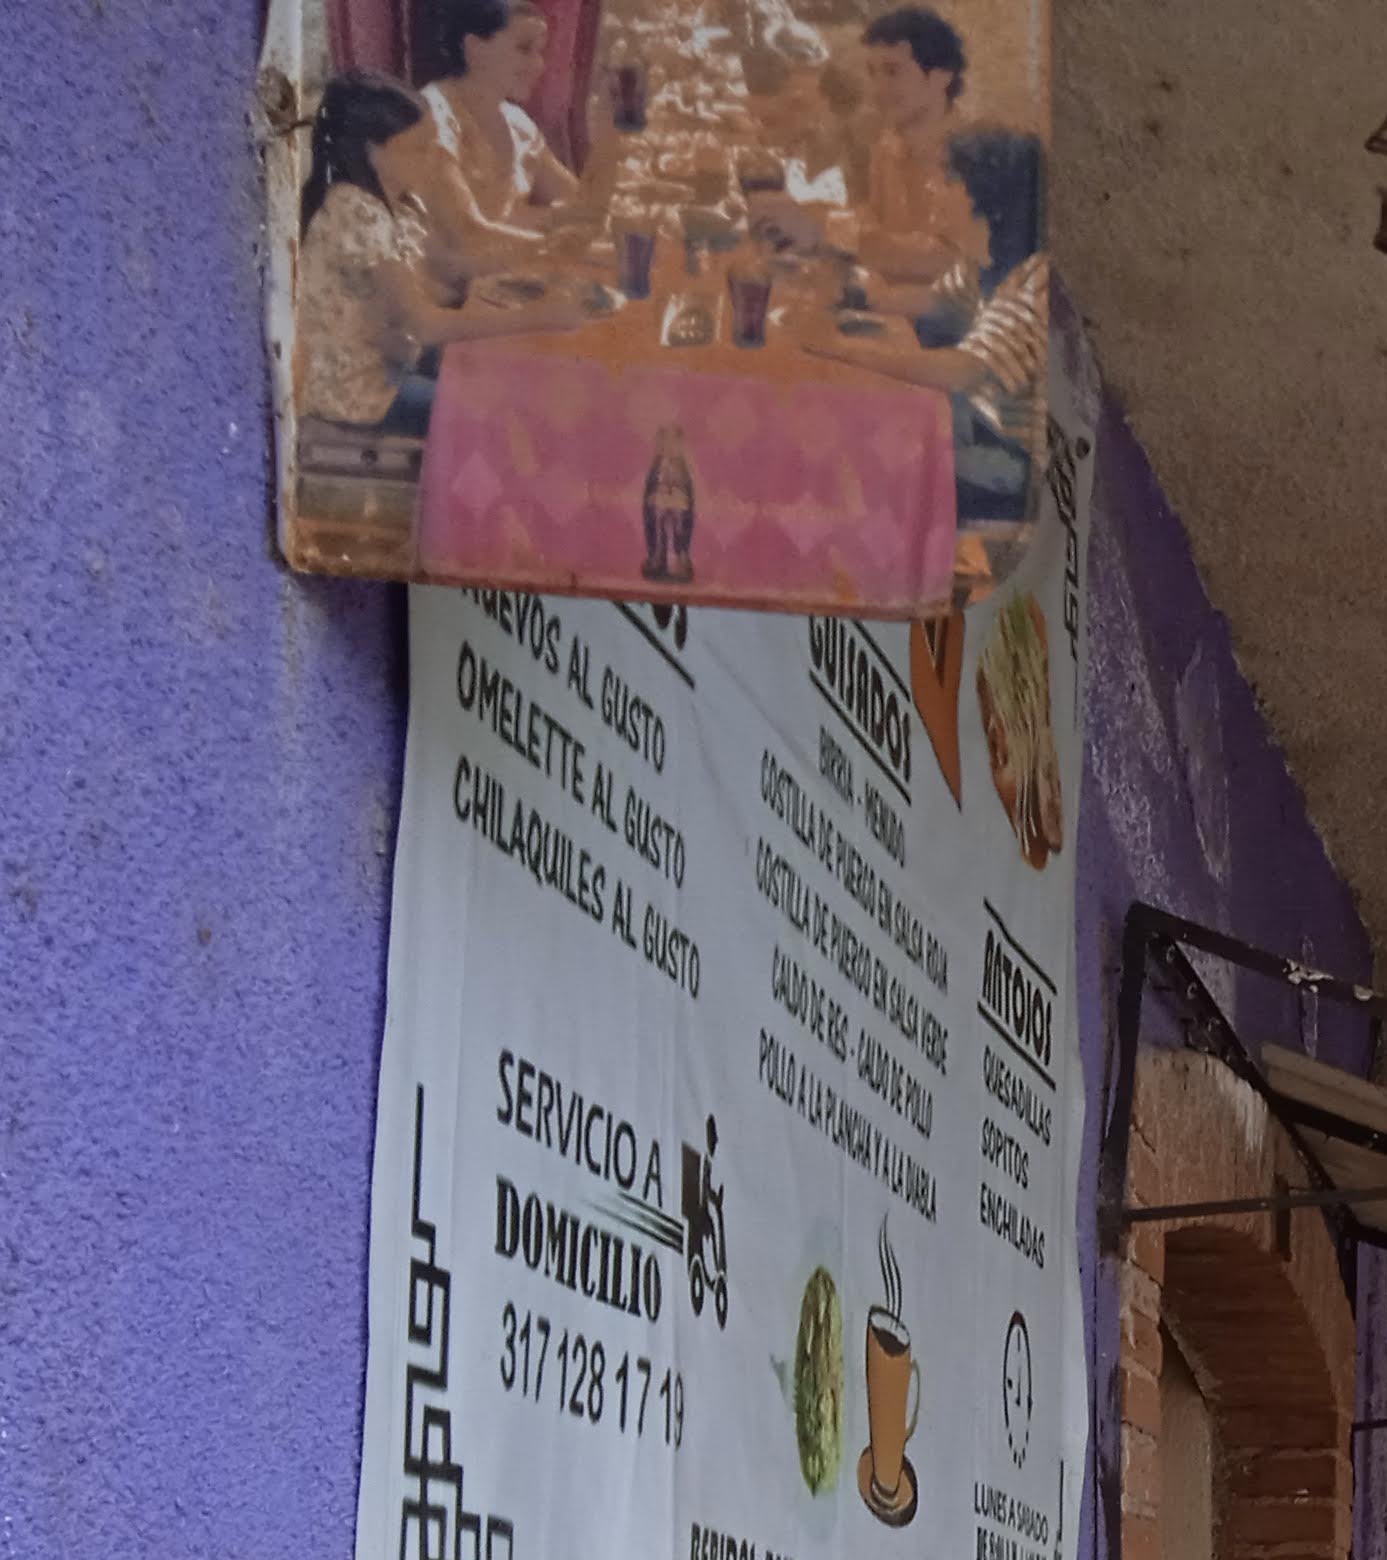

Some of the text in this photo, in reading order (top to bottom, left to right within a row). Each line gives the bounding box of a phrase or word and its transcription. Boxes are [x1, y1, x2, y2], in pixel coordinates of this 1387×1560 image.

[461, 587, 561, 675] UEVOS
[568, 635, 594, 710] AL
[602, 664, 665, 774] GUSTO
[809, 614, 911, 783] GUISADOS
[457, 640, 685, 889] OMELETTE AL GUSTO
[454, 754, 700, 999] CHILAQUILES AL GUSTO
[761, 749, 815, 853] COSTILLA
[819, 809, 833, 873] DE
[836, 830, 876, 918] PUERCO
[878, 879, 892, 937] EN
[894, 901, 924, 970] SALSA
[756, 836, 810, 938] COSTILLA
[813, 893, 828, 955] DE
[830, 912, 871, 997] PUERCO
[873, 956, 888, 1014] EN
[889, 977, 918, 1047] SALSA
[759, 1027, 795, 1107] POLLO
[797, 1065, 806, 1118] A
[808, 1072, 822, 1131] LA
[825, 1085, 872, 1171] PLANCHA
[772, 944, 933, 1139] CALDO DE RES CALDO DE POLLO
[983, 1045, 1051, 1147] QUESADILLAS
[497, 1048, 662, 1208] SERVICIO A
[981, 1116, 1029, 1189] SOPITOS
[494, 1173, 662, 1324] DOMICILIO
[980, 1181, 1045, 1269] ENCHILADAS
[500, 1300, 550, 1404] 317
[557, 1328, 606, 1425] 128
[974, 1482, 1006, 1525] LUNES
